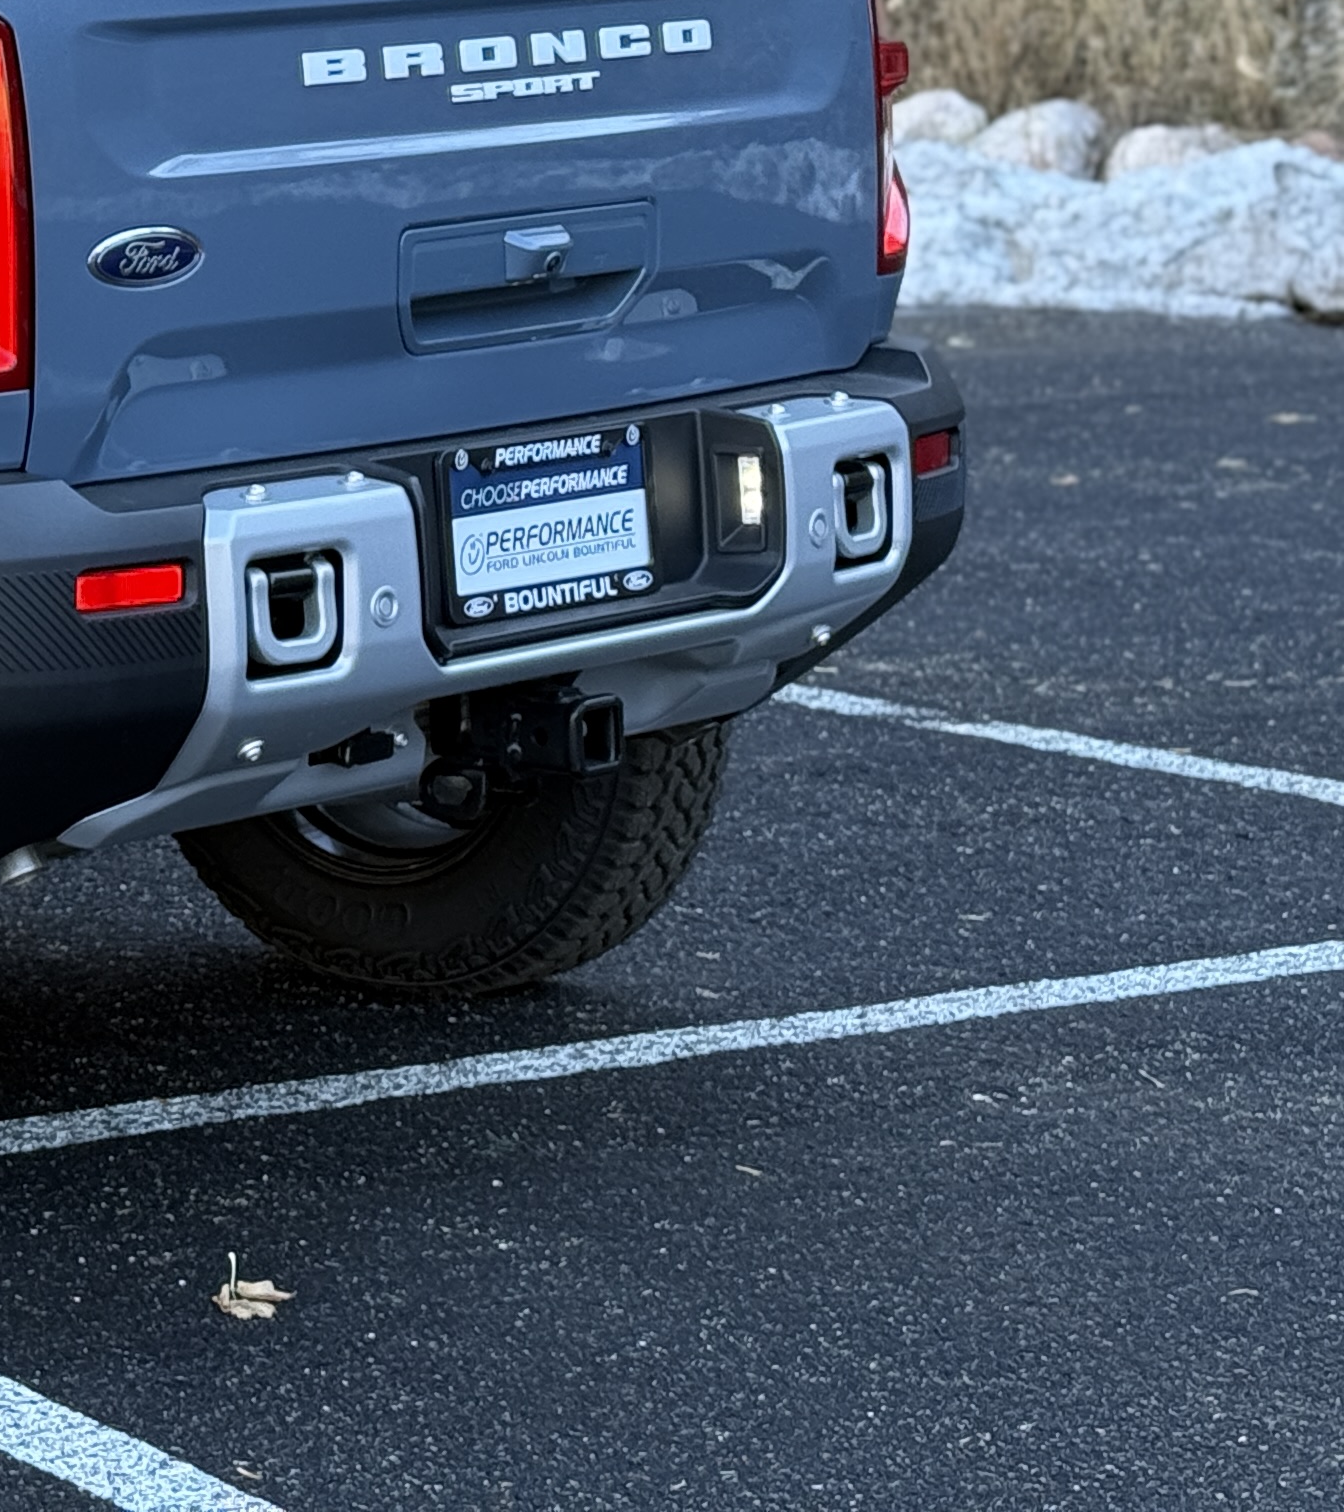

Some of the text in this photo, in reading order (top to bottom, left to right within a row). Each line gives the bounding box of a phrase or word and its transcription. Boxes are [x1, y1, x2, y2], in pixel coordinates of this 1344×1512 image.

[300, 18, 712, 87] BRONCO
[449, 70, 601, 104] SPORT
[118, 239, 181, 277] Ford
[494, 433, 602, 469] PERFORMANCE
[485, 507, 635, 556] PERFORMANCE
[486, 537, 637, 574] FORD LINCOLN BOUNTIFUL
[503, 575, 619, 615] BOUNTIFUL
